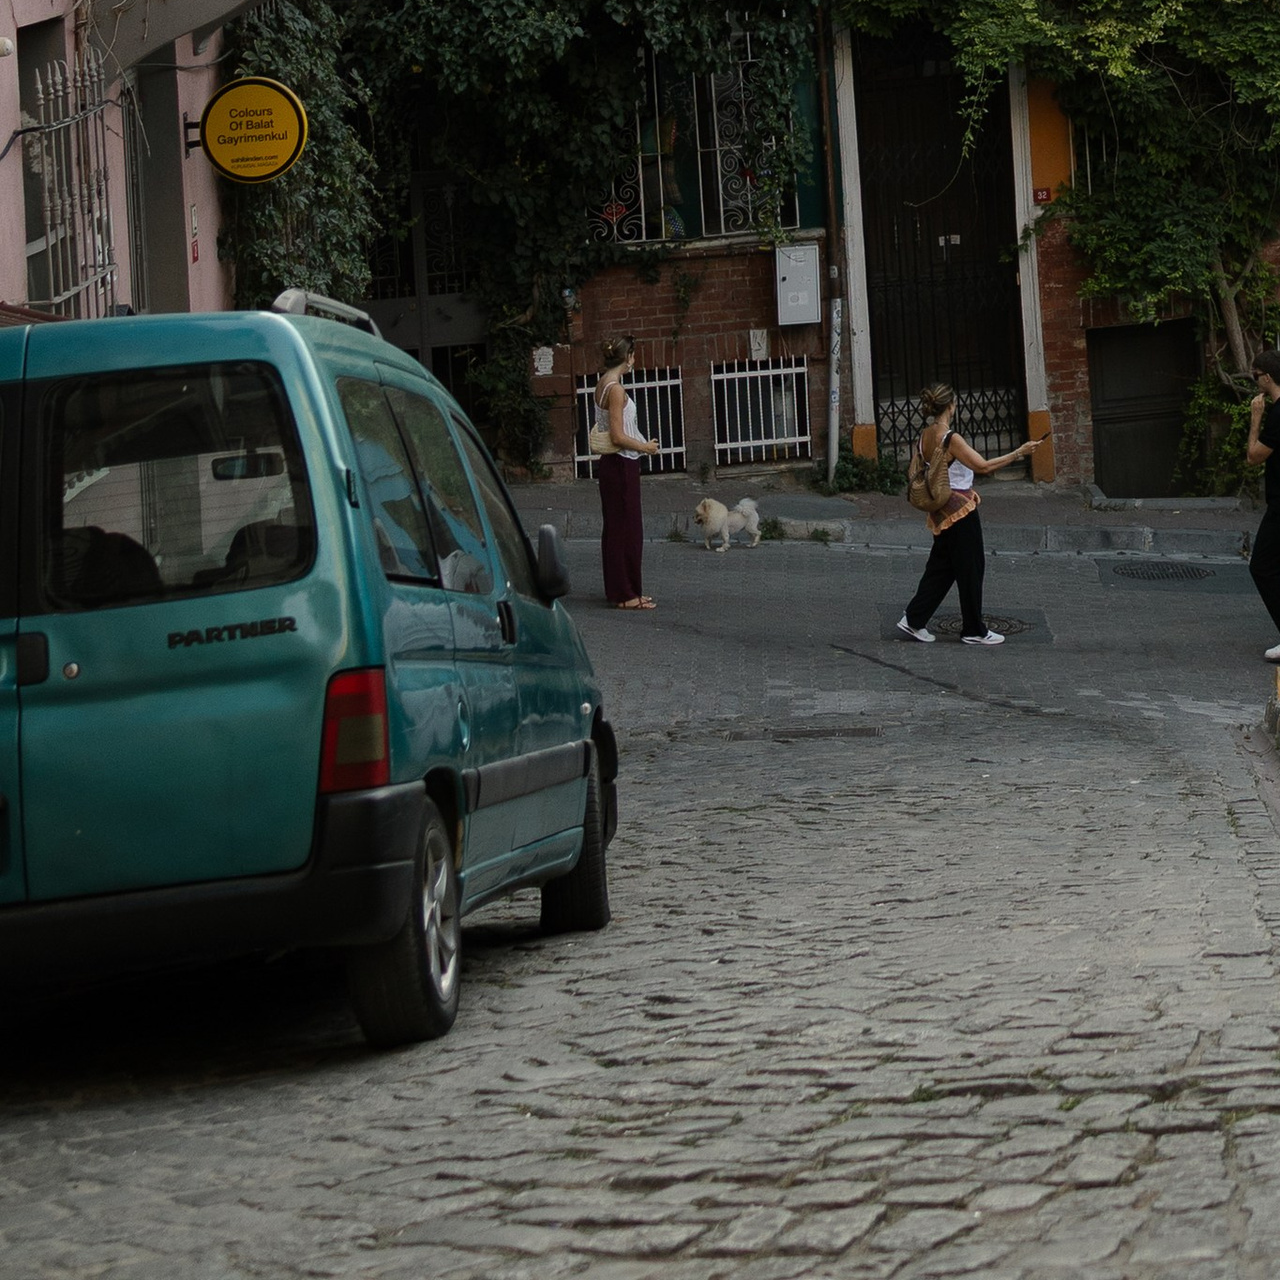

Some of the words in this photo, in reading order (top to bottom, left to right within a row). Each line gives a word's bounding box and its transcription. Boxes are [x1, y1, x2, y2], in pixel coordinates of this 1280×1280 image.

[229, 108, 273, 118] Colours
[229, 121, 243, 131] Of
[245, 119, 274, 130] Balat
[217, 130, 288, 146] Gayrimenkul
[167, 616, 298, 650] PARTNER
